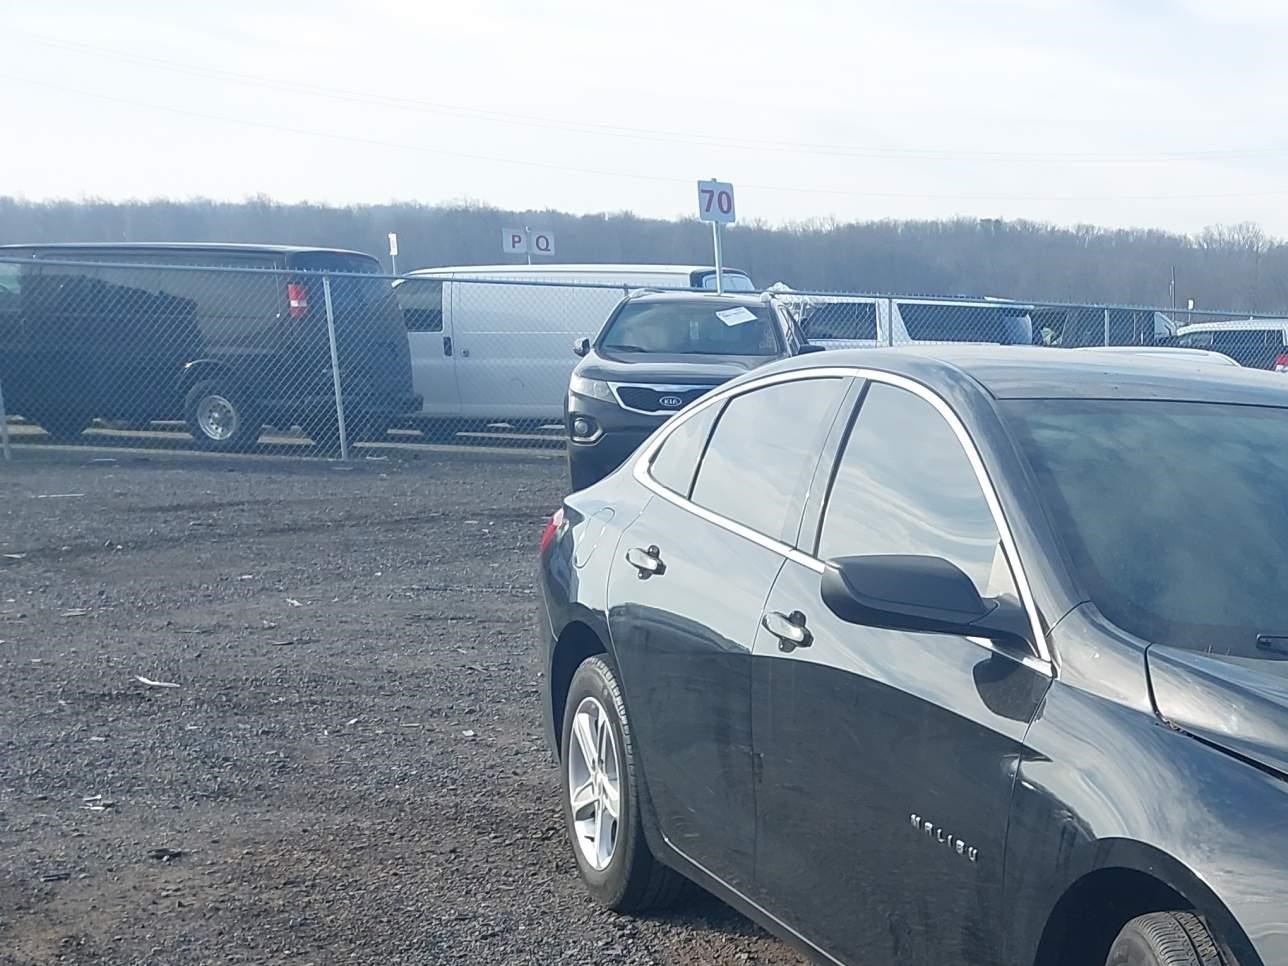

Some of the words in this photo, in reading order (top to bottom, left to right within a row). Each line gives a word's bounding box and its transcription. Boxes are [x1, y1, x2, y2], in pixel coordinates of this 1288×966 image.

[701, 189, 732, 214] 70
[511, 234, 522, 249] P
[535, 235, 551, 252] Q
[910, 814, 978, 862] MALIBU
